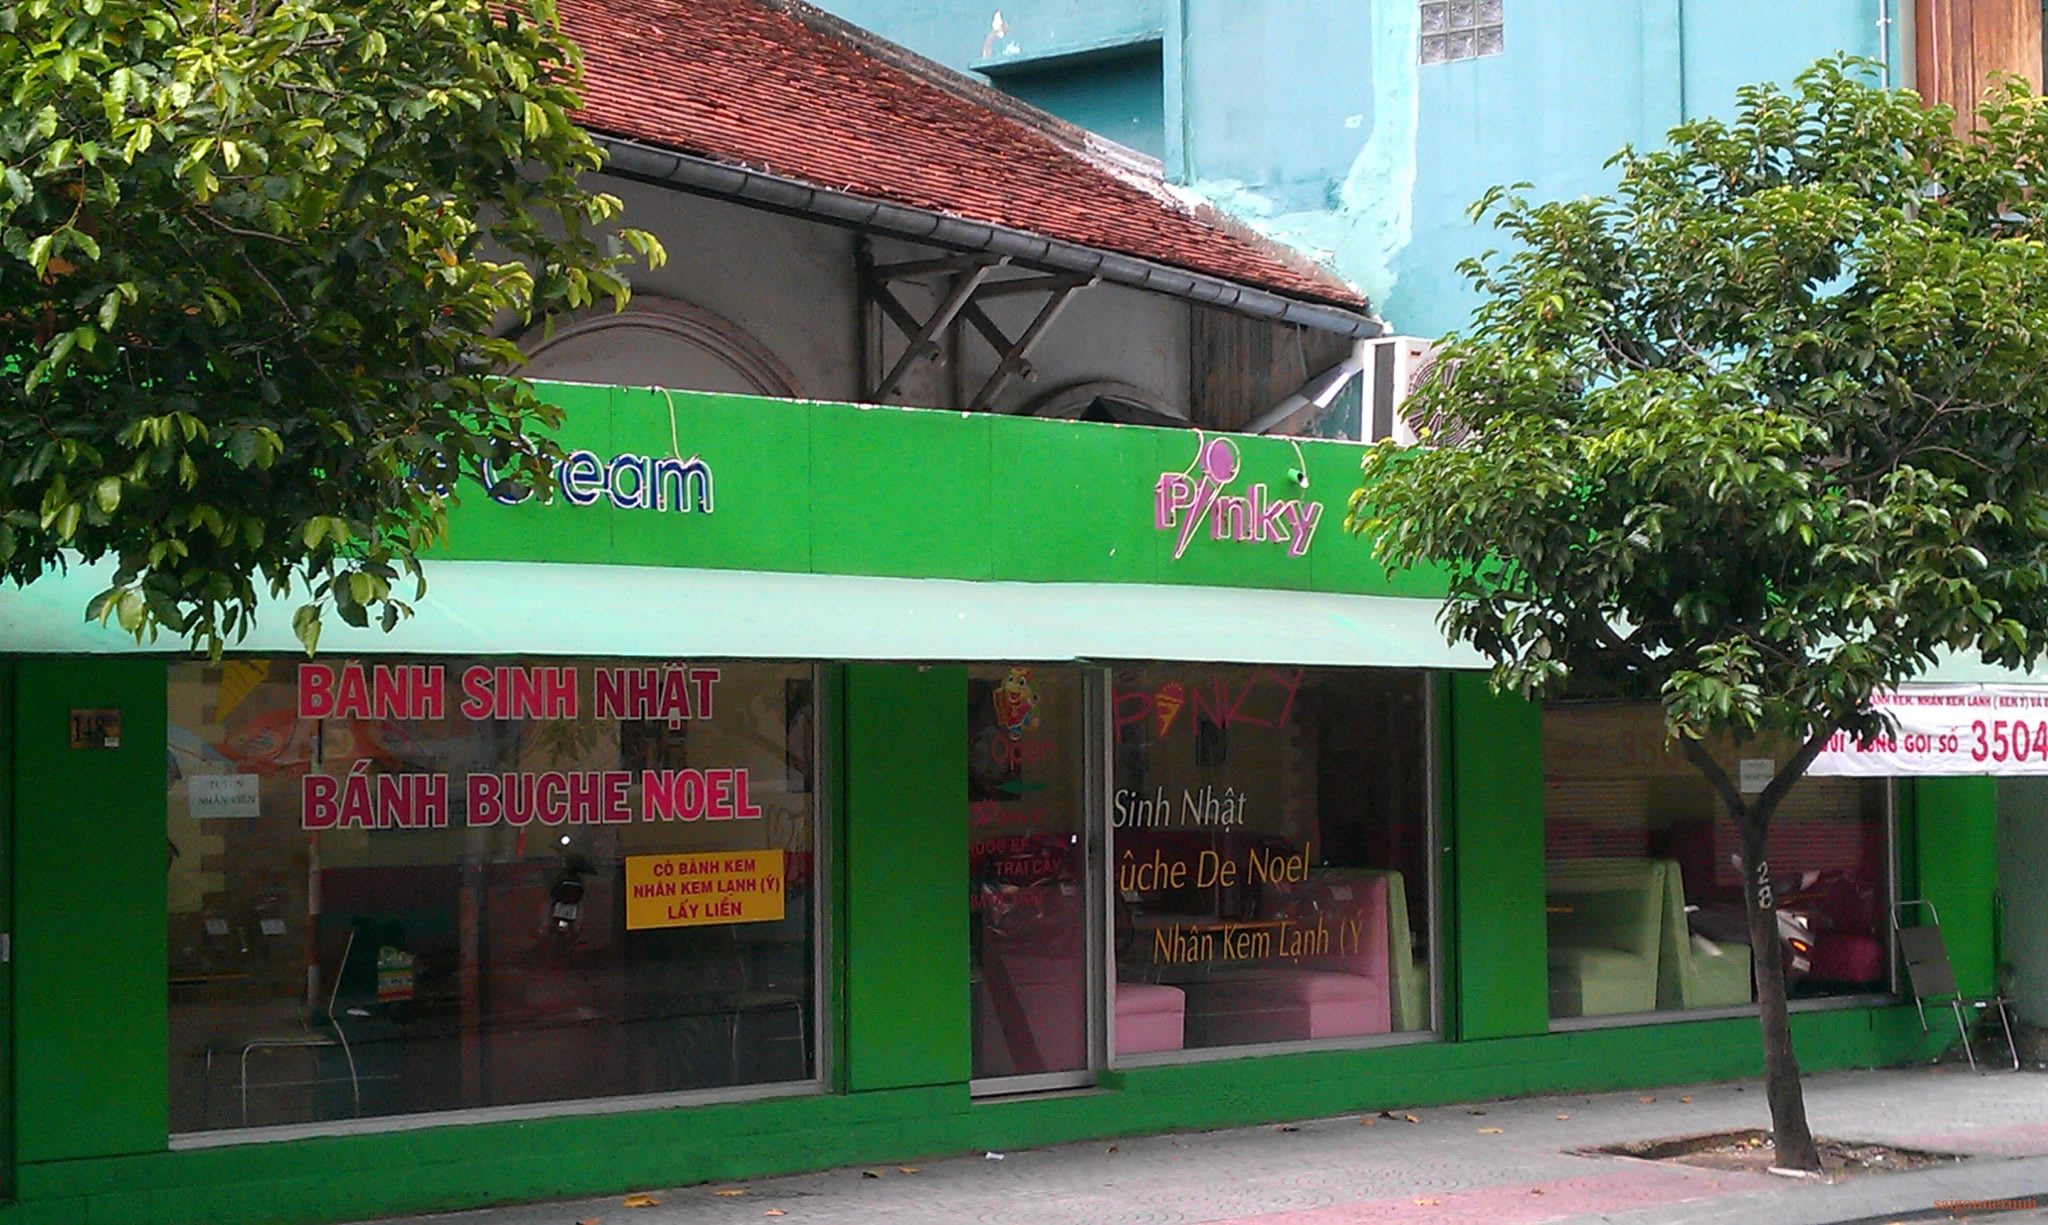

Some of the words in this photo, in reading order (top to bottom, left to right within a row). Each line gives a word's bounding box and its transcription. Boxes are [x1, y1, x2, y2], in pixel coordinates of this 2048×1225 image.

[480, 433, 715, 514] Ceam
[298, 660, 444, 720] BÁNH
[460, 666, 578, 720] SINH
[594, 662, 720, 730] NHẬT
[1938, 726, 1958, 753] SỐ
[1971, 719, 2048, 762] 3504
[302, 760, 446, 829] BÁNH
[467, 771, 632, 827] BUCHE
[642, 768, 761, 823] NOEL
[1112, 786, 1171, 828] Sinh
[1181, 784, 1248, 833] Nhật
[679, 858, 719, 876] BÁNH
[724, 859, 756, 873] KEM
[681, 879, 713, 895] KEM
[717, 877, 756, 896] LẠNH
[1197, 850, 1237, 888] De
[1248, 842, 1310, 886] Noel
[668, 899, 699, 920] LẤY
[705, 896, 742, 917] LIỀN
[1153, 924, 1213, 964] Nhân
[1222, 921, 1270, 961] Kem
[1279, 915, 1329, 964] Lạnh
